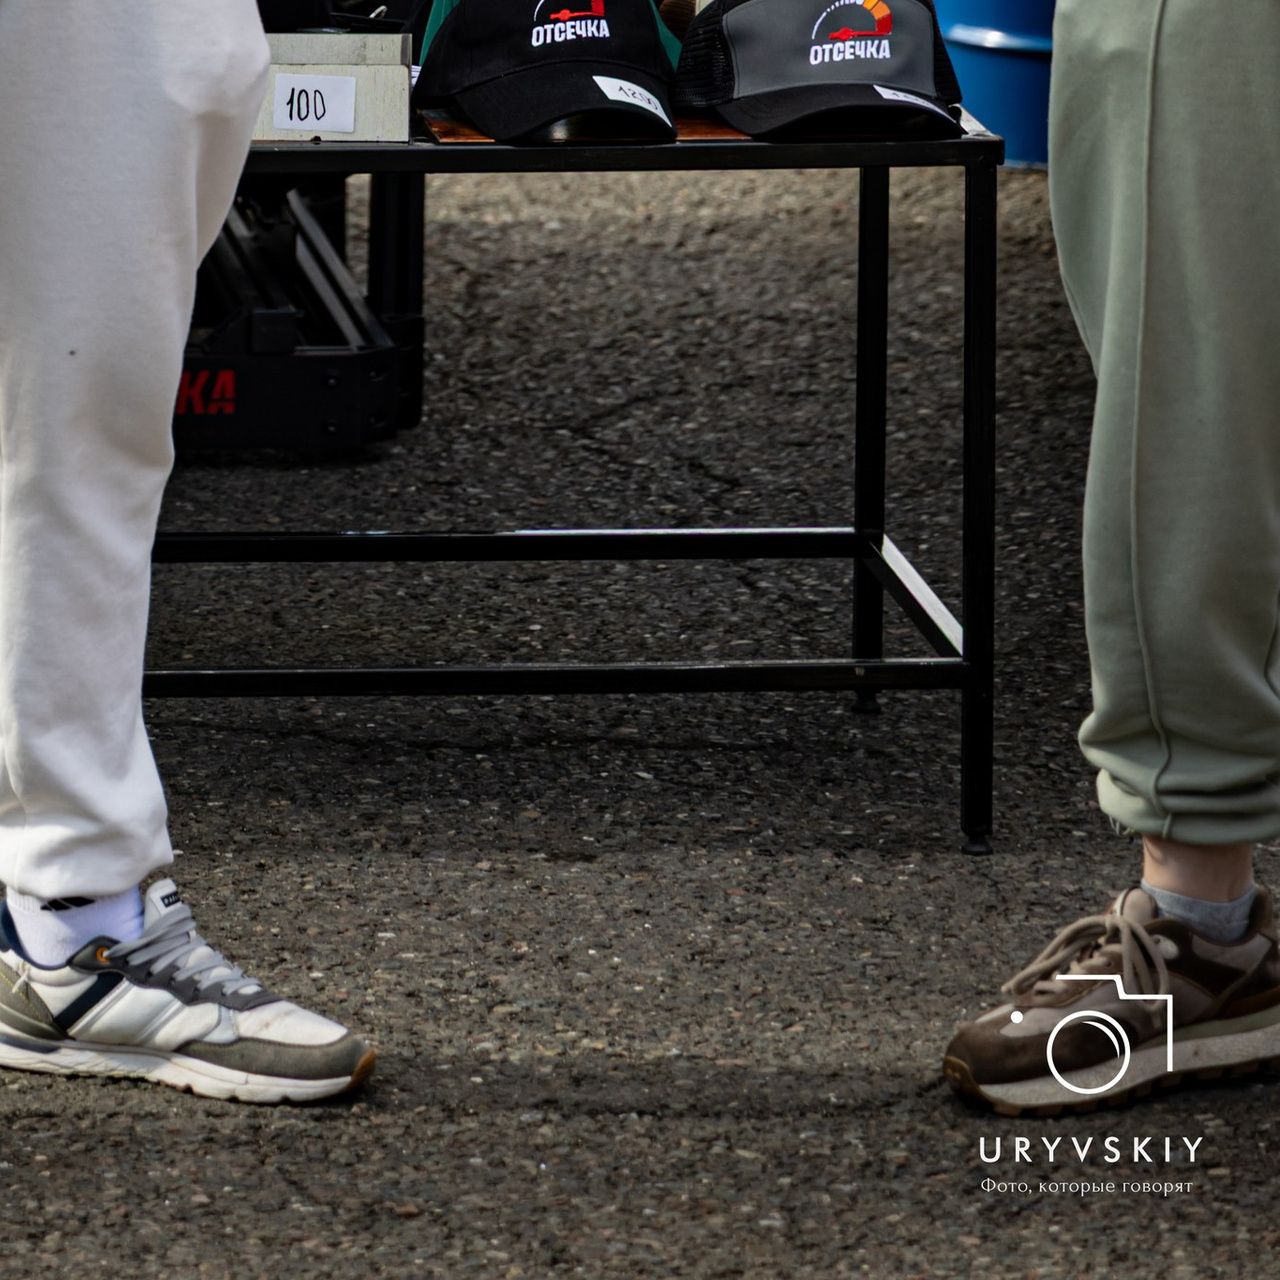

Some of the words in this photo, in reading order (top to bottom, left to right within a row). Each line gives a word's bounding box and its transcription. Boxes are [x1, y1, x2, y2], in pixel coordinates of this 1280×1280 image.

[531, 18, 611, 47] ОТСЕЧКА
[809, 39, 892, 65] ОТСЕЧКА
[286, 87, 326, 121] 100
